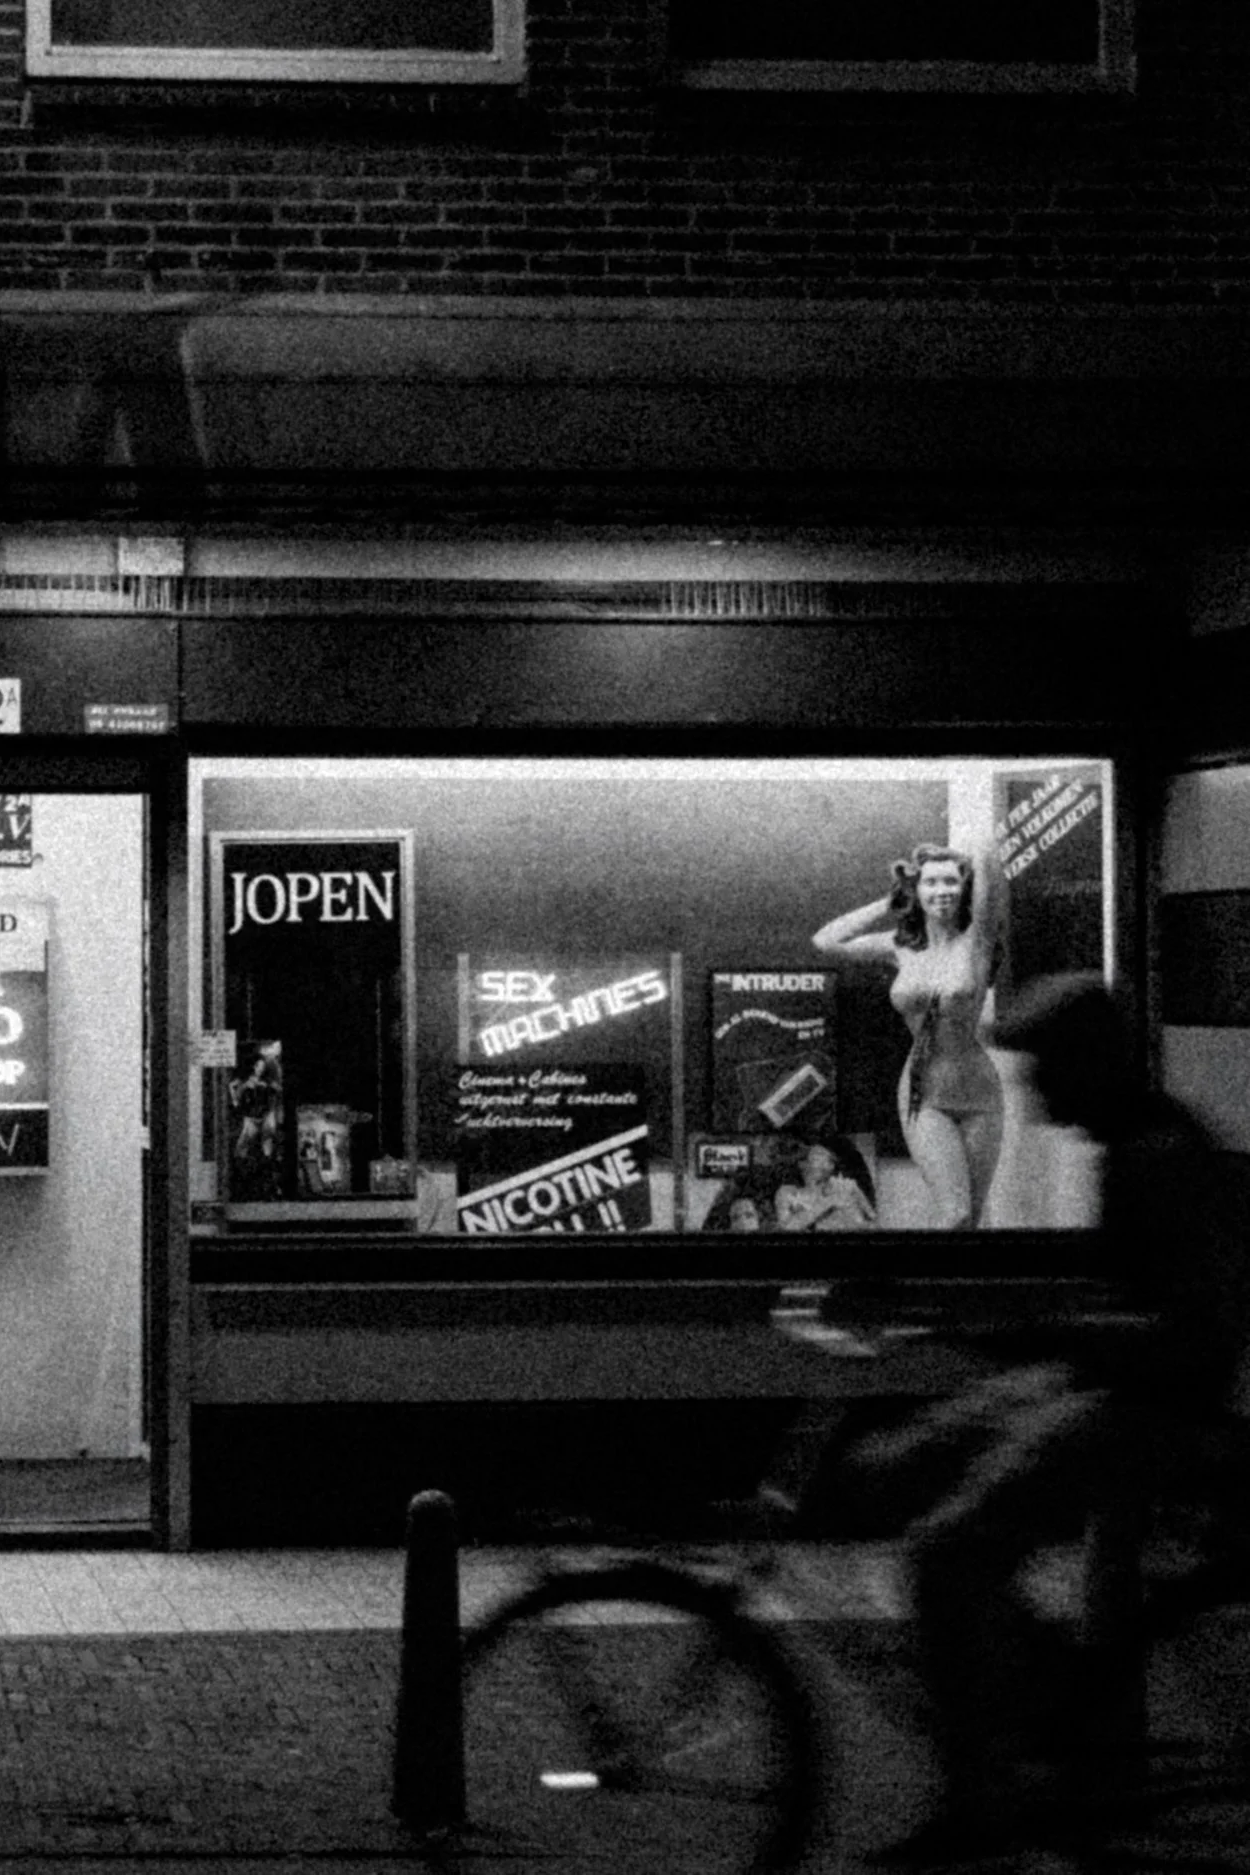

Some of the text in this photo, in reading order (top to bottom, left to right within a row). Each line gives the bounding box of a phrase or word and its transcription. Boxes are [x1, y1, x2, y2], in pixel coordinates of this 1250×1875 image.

[228, 870, 396, 935] JOPEN
[480, 971, 556, 1002] SEX
[732, 972, 825, 992] INTRUDER
[479, 969, 668, 1057] MACHINES
[458, 1069, 514, 1090] Cinema
[528, 1069, 588, 1089] Cabines
[461, 1147, 643, 1234] NICOTINE
